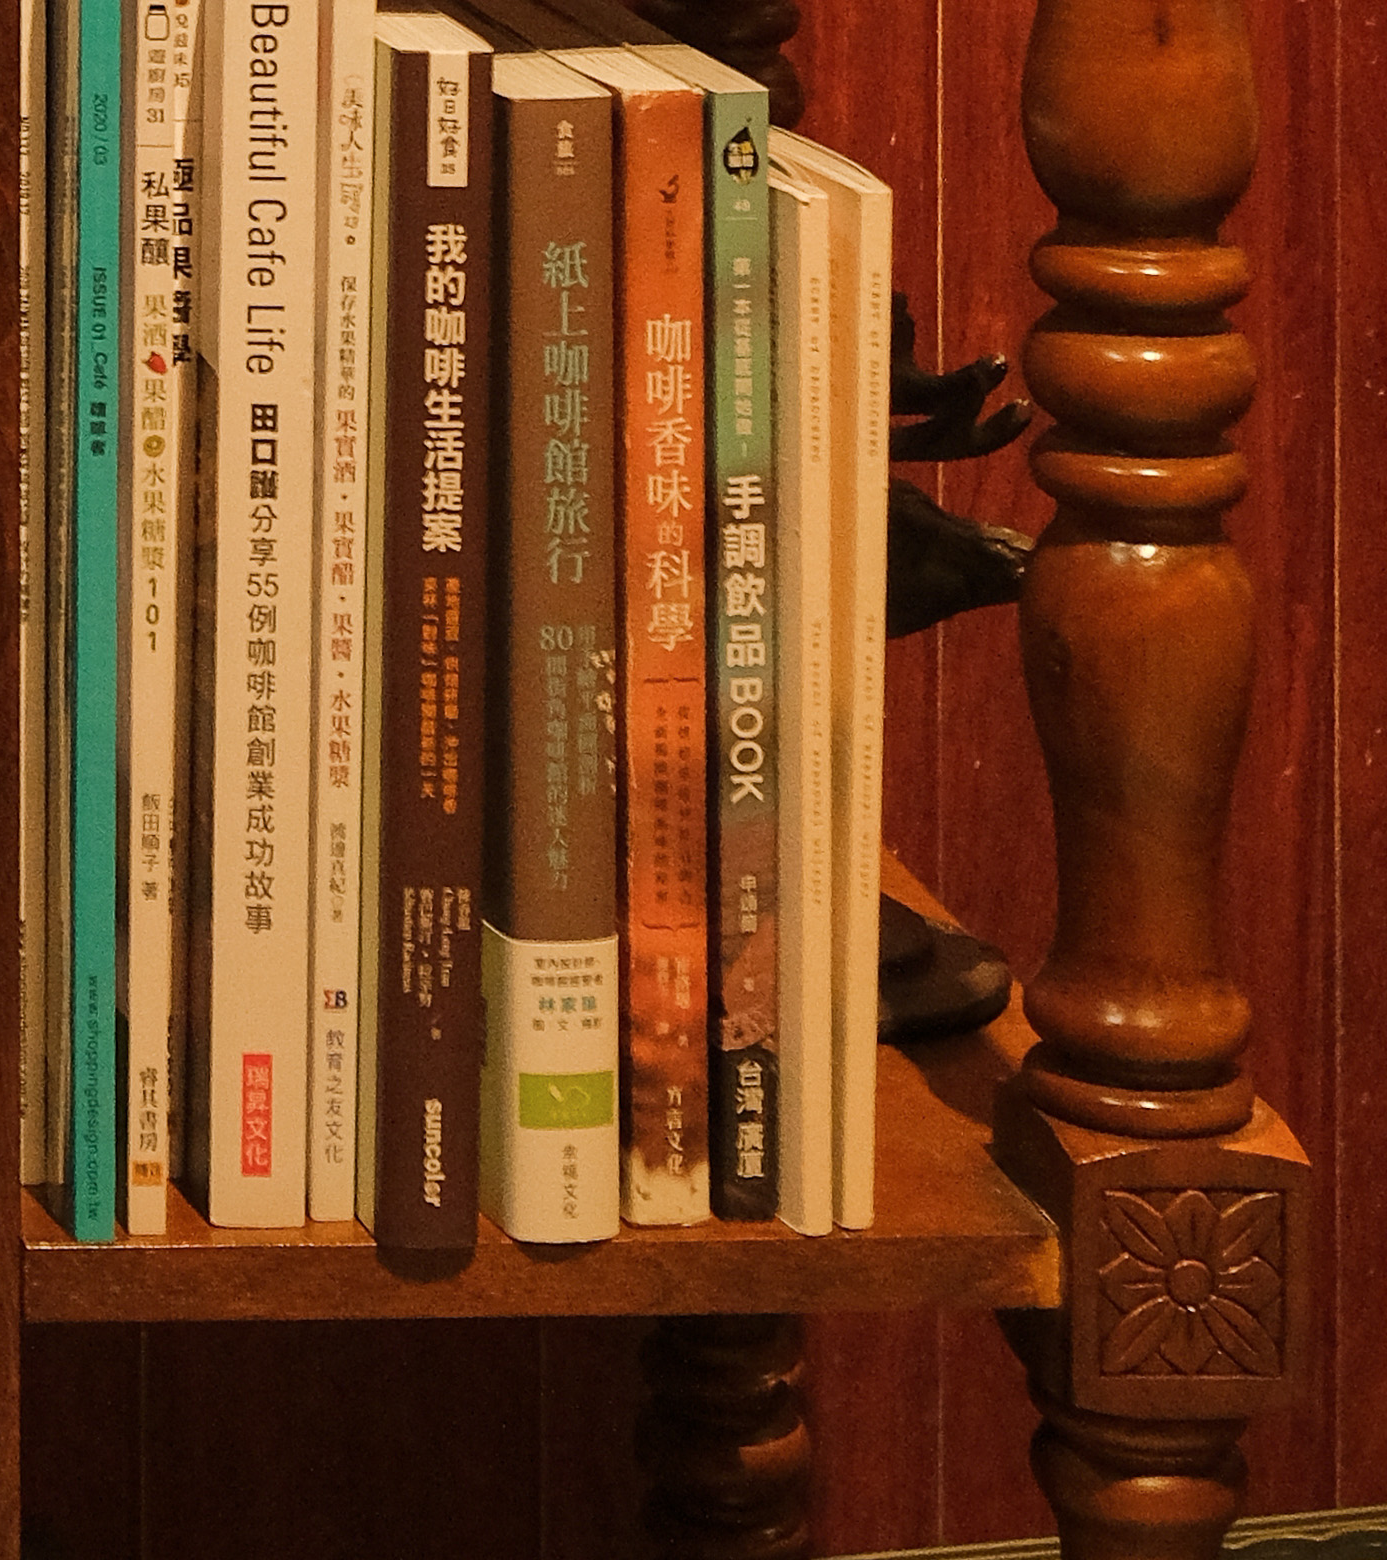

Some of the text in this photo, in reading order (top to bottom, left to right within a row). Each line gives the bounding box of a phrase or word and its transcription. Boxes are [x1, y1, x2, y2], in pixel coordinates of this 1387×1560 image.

[246, 2, 290, 183] Beautiful
[140, 171, 170, 267] 私果釀
[246, 198, 289, 289] Cafe
[91, 266, 108, 320] ISSUE
[244, 304, 287, 376] Life
[140, 294, 168, 433] 果酒 果醋
[421, 223, 469, 554] 我的咖啡生活提案
[542, 238, 590, 585] 紙上咖啡館旅行
[644, 312, 695, 653] 咖啡香味的科學
[721, 473, 768, 805] 手調飲品BOOK
[245, 1065, 272, 1168] 瑞昇文化
[423, 1097, 446, 1209] suncolor
